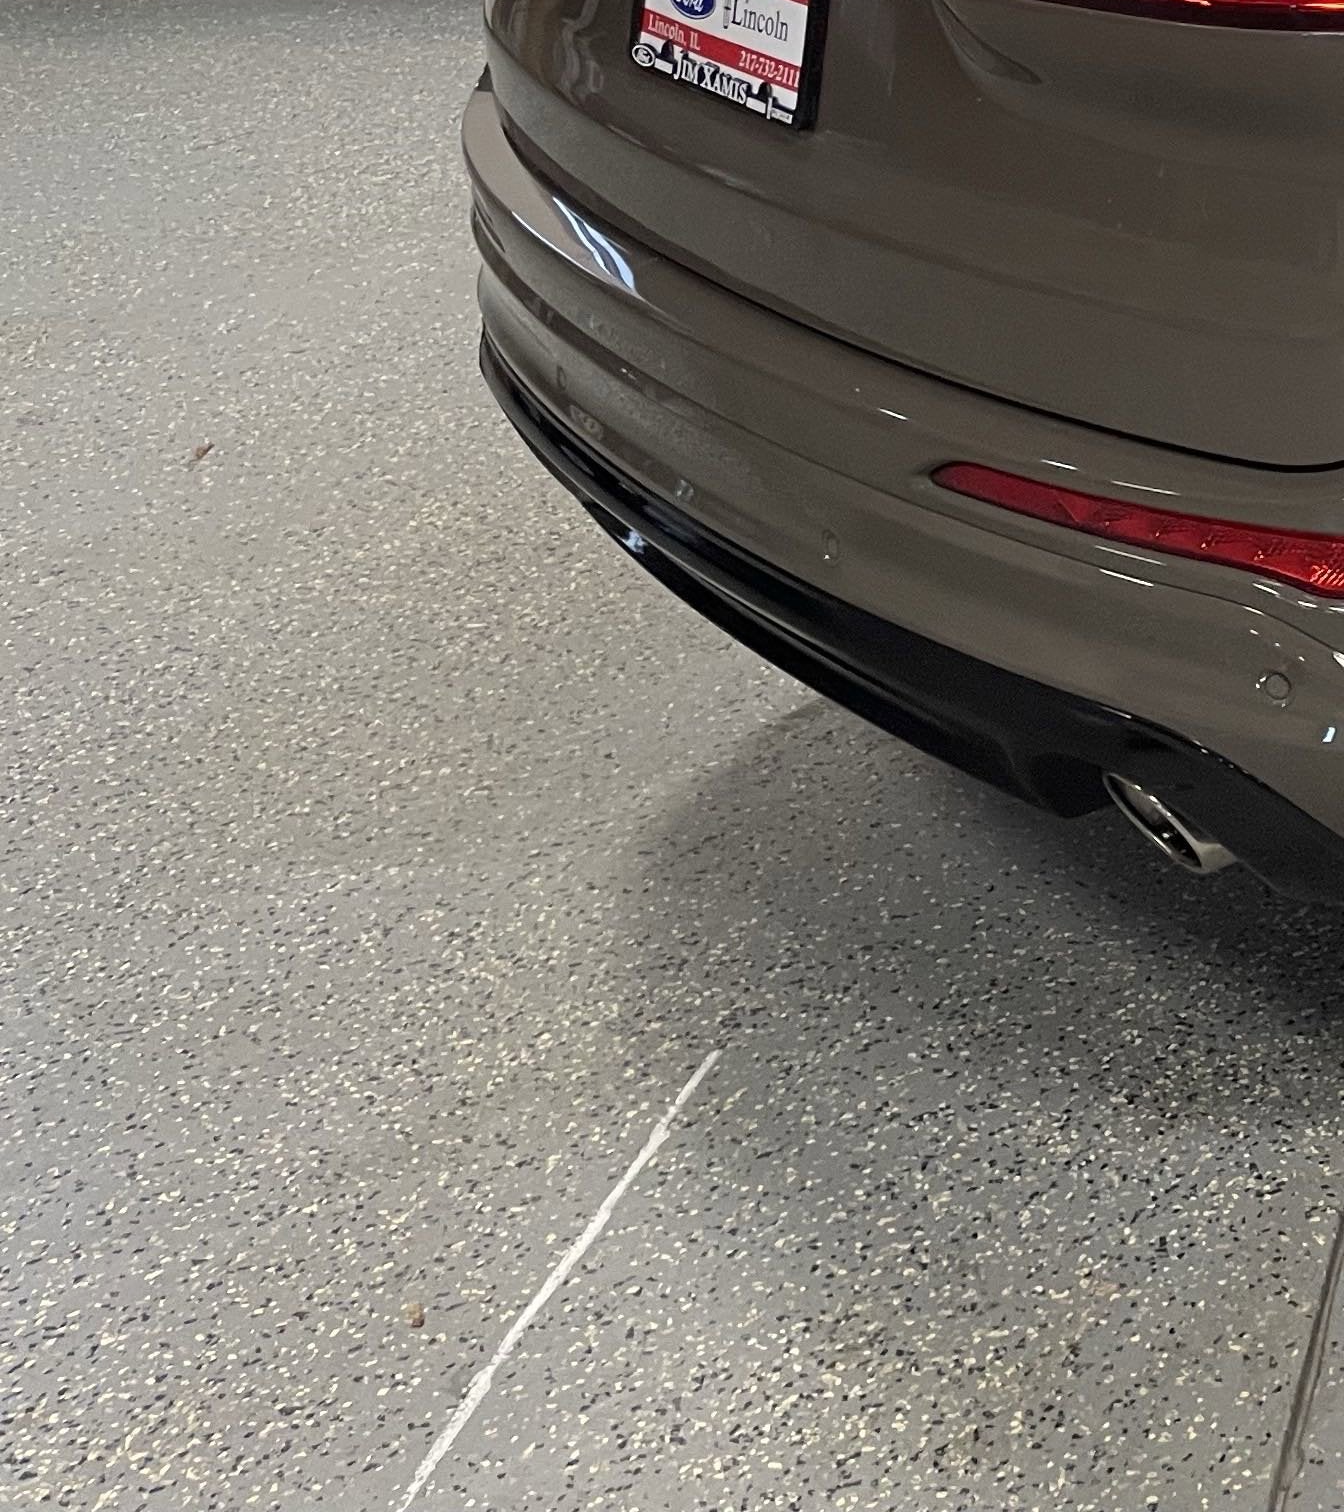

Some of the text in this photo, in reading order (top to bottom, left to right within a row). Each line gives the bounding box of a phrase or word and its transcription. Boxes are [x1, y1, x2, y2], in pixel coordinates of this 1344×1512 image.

[688, 31, 701, 50] IL
[673, 52, 700, 85] JIM
[702, 63, 748, 105] XAMIS
